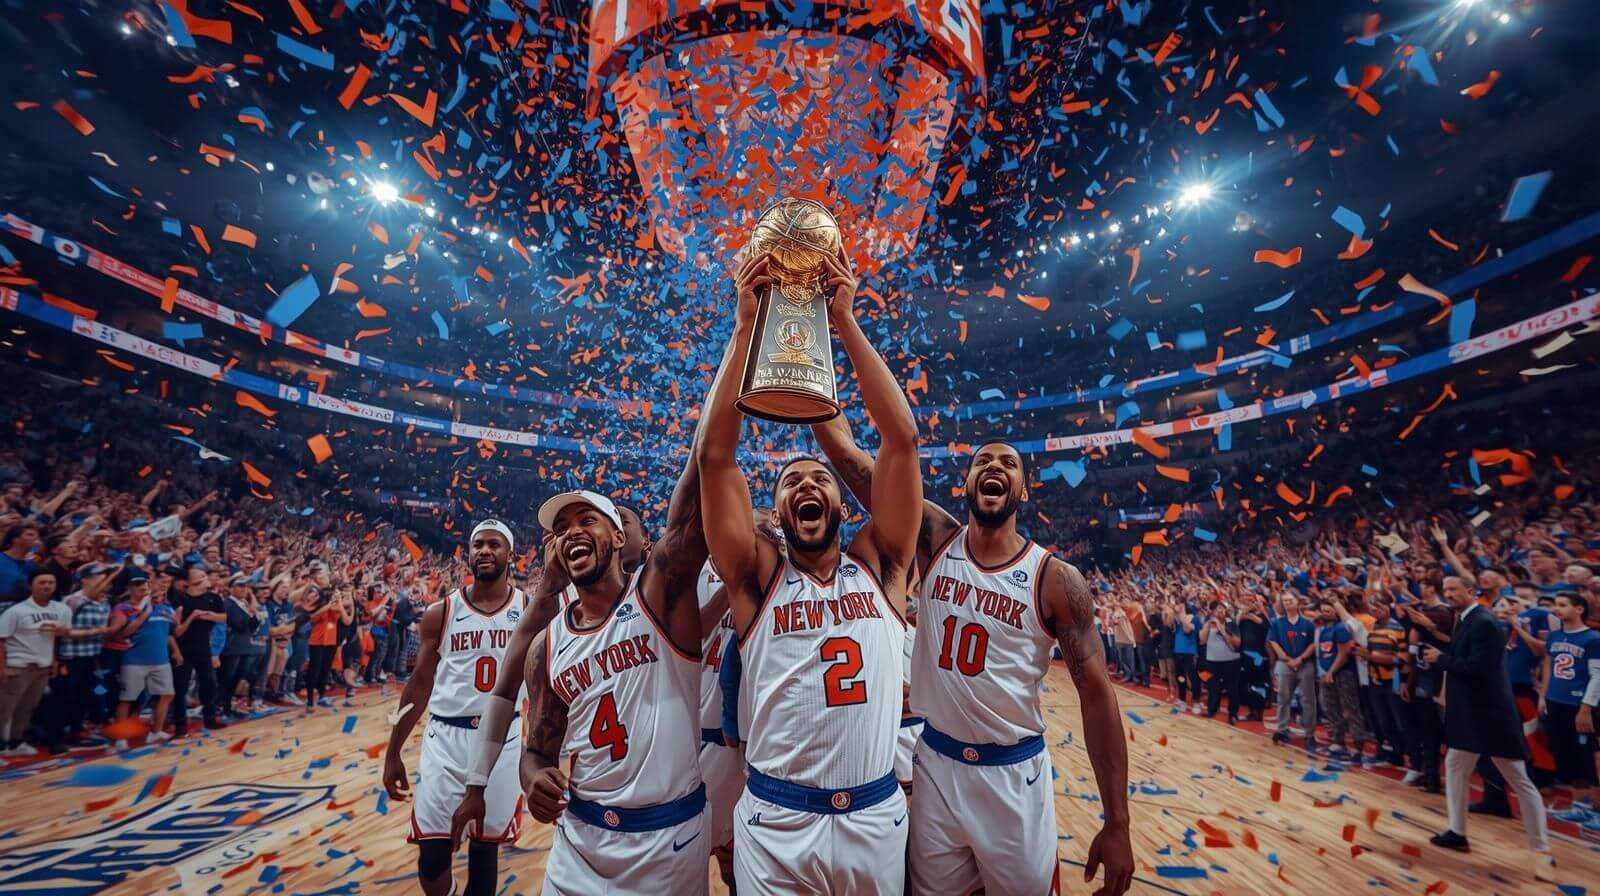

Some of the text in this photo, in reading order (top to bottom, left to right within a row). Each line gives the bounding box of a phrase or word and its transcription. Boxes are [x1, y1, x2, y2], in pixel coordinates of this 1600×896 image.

[773, 601, 825, 635] NEW
[828, 592, 883, 625] YORK
[931, 575, 971, 608] NEW
[973, 585, 1027, 629] YORK
[450, 631, 484, 651] NEW
[938, 614, 988, 677] 10
[1554, 653, 1575, 680] 2
[474, 656, 497, 693] 0
[553, 634, 658, 704] NEW YORK
[820, 636, 867, 707] 2
[588, 691, 628, 762] 4
